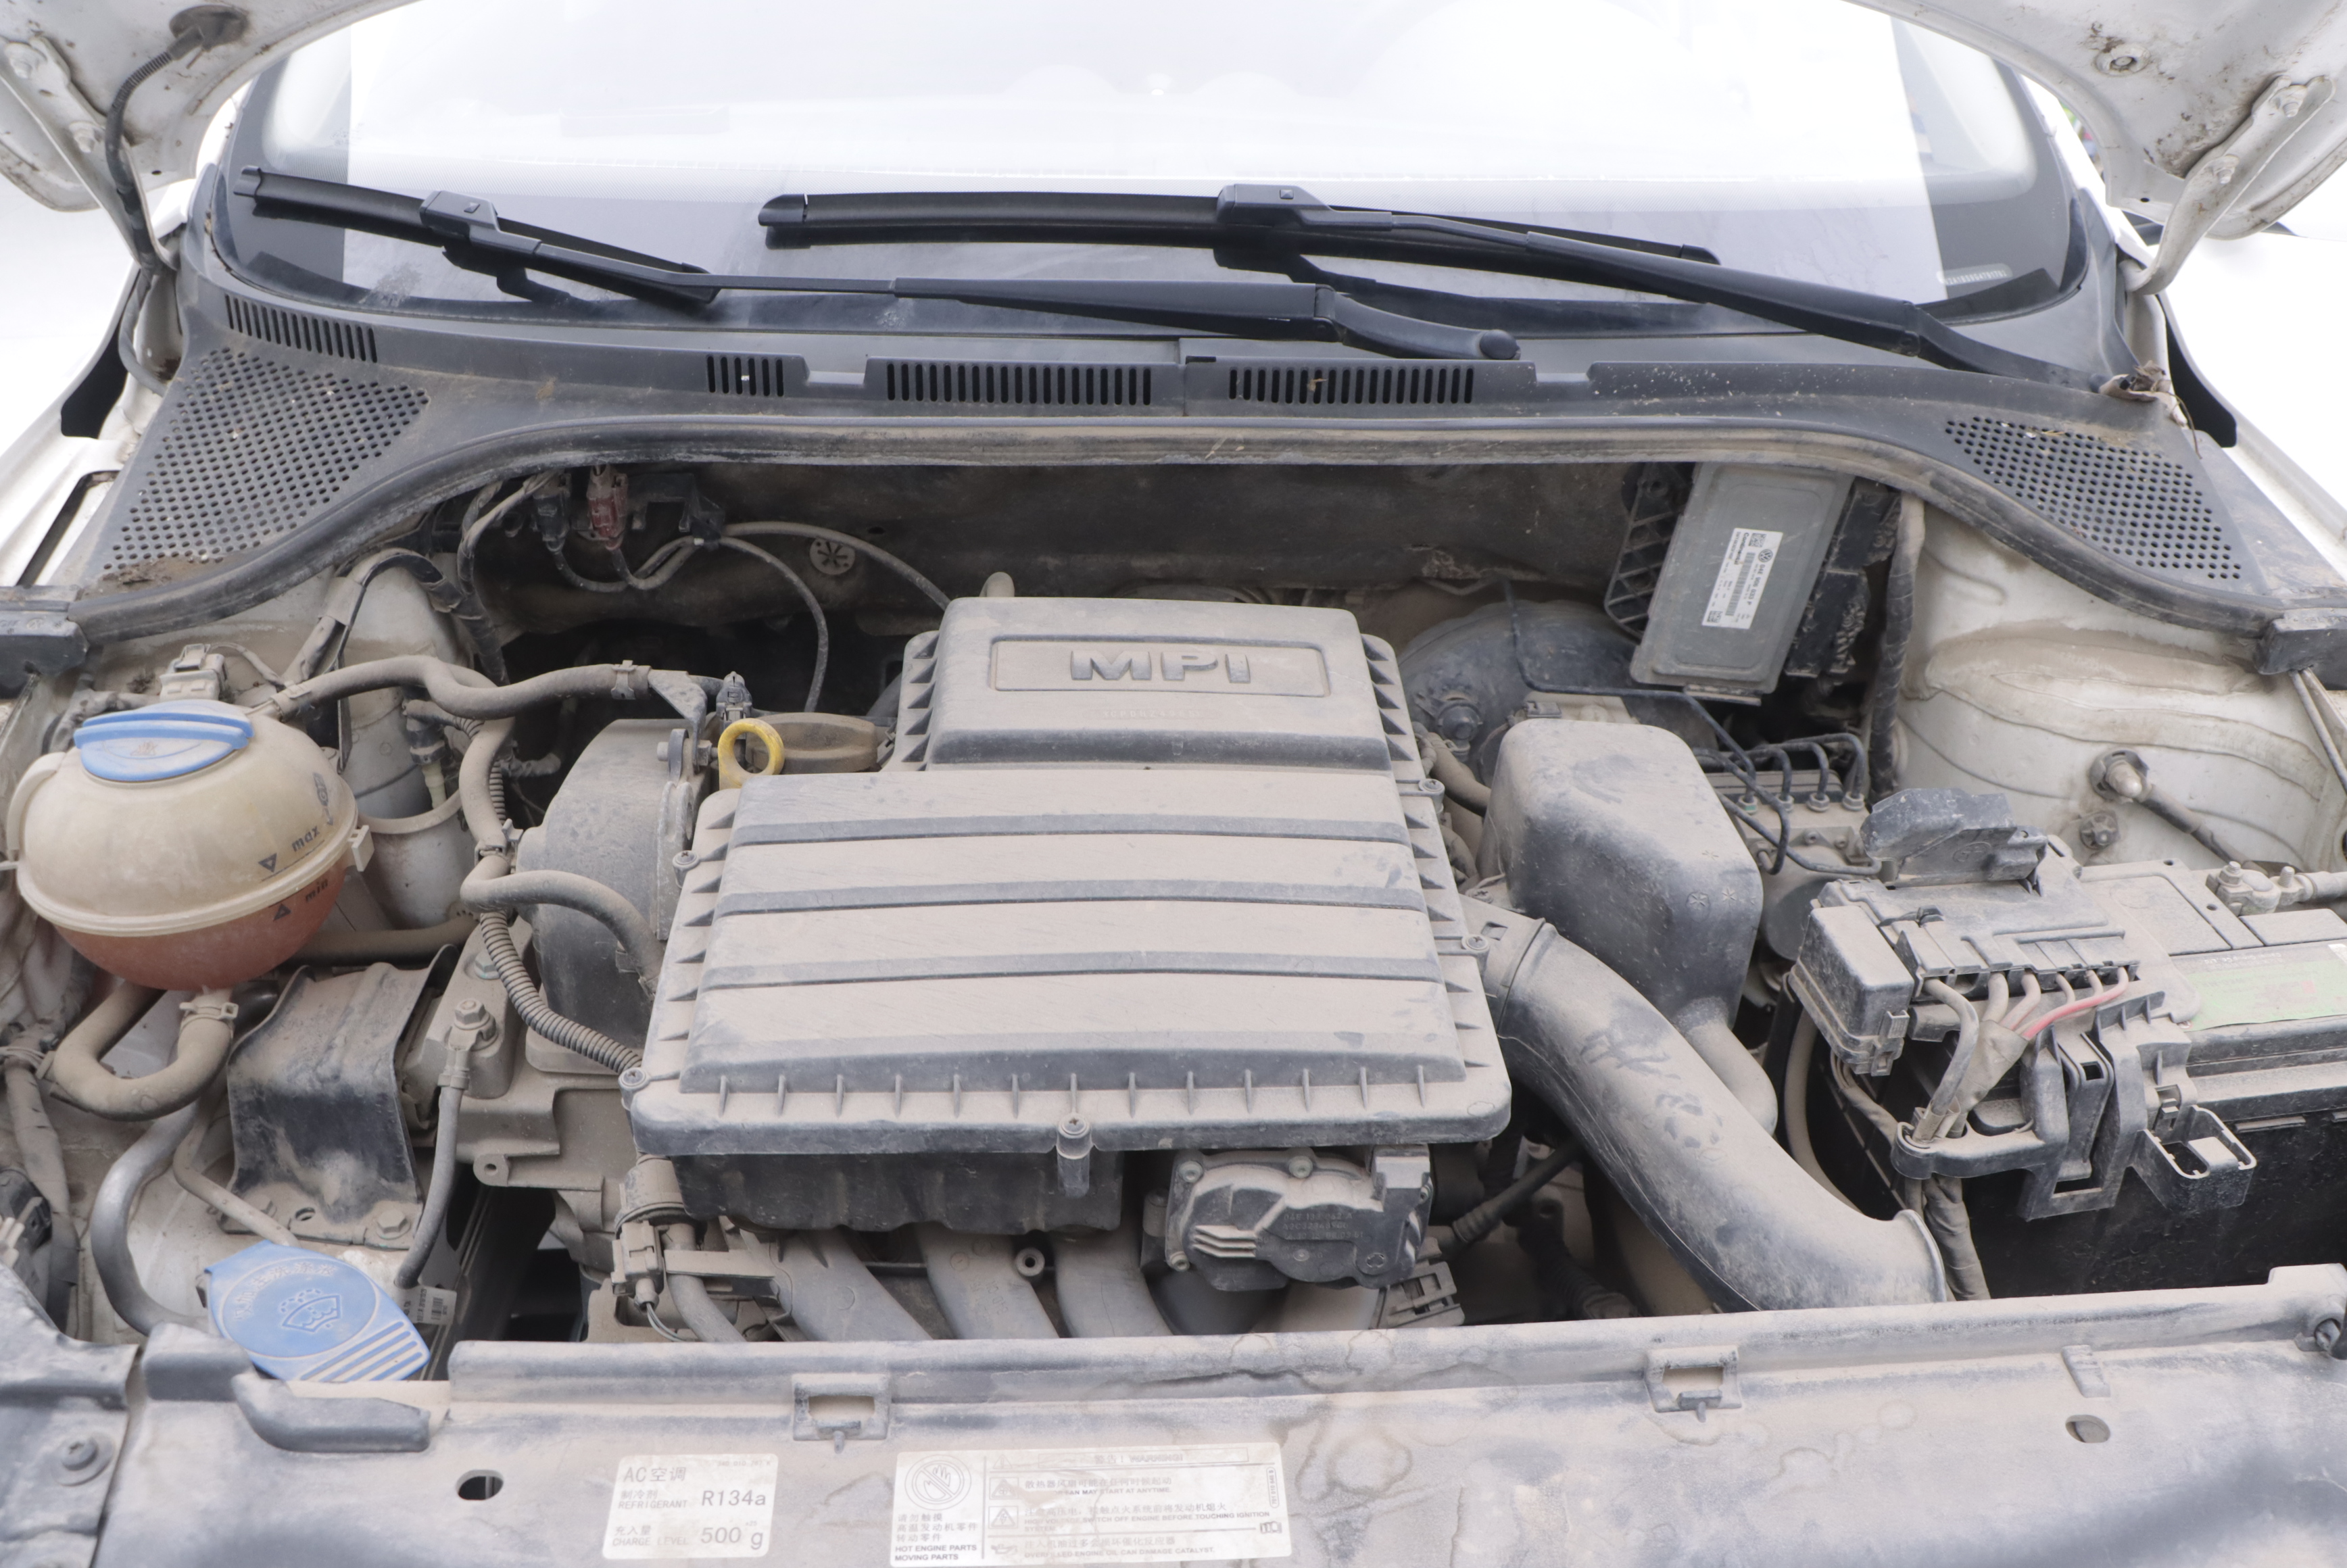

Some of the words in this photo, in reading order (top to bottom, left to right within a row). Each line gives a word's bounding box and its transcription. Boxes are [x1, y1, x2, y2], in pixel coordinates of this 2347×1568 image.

[1071, 650, 1251, 683] MPI
[291, 826, 320, 852] max
[306, 879, 329, 902] min
[619, 1500, 688, 1509] REFRIGERANT
[701, 1490, 766, 1506] R134a
[621, 1490, 658, 1499] 制冷剂
[898, 1513, 943, 1522] 请勿触摸
[614, 1525, 651, 1536] 充入量
[897, 1522, 978, 1532] 高温发动机零件
[612, 1538, 651, 1546] CHARGE
[657, 1537, 689, 1546] LEVEL
[701, 1527, 742, 1544] 500
[750, 1532, 763, 1550] g
[896, 1533, 942, 1542] 转动零件
